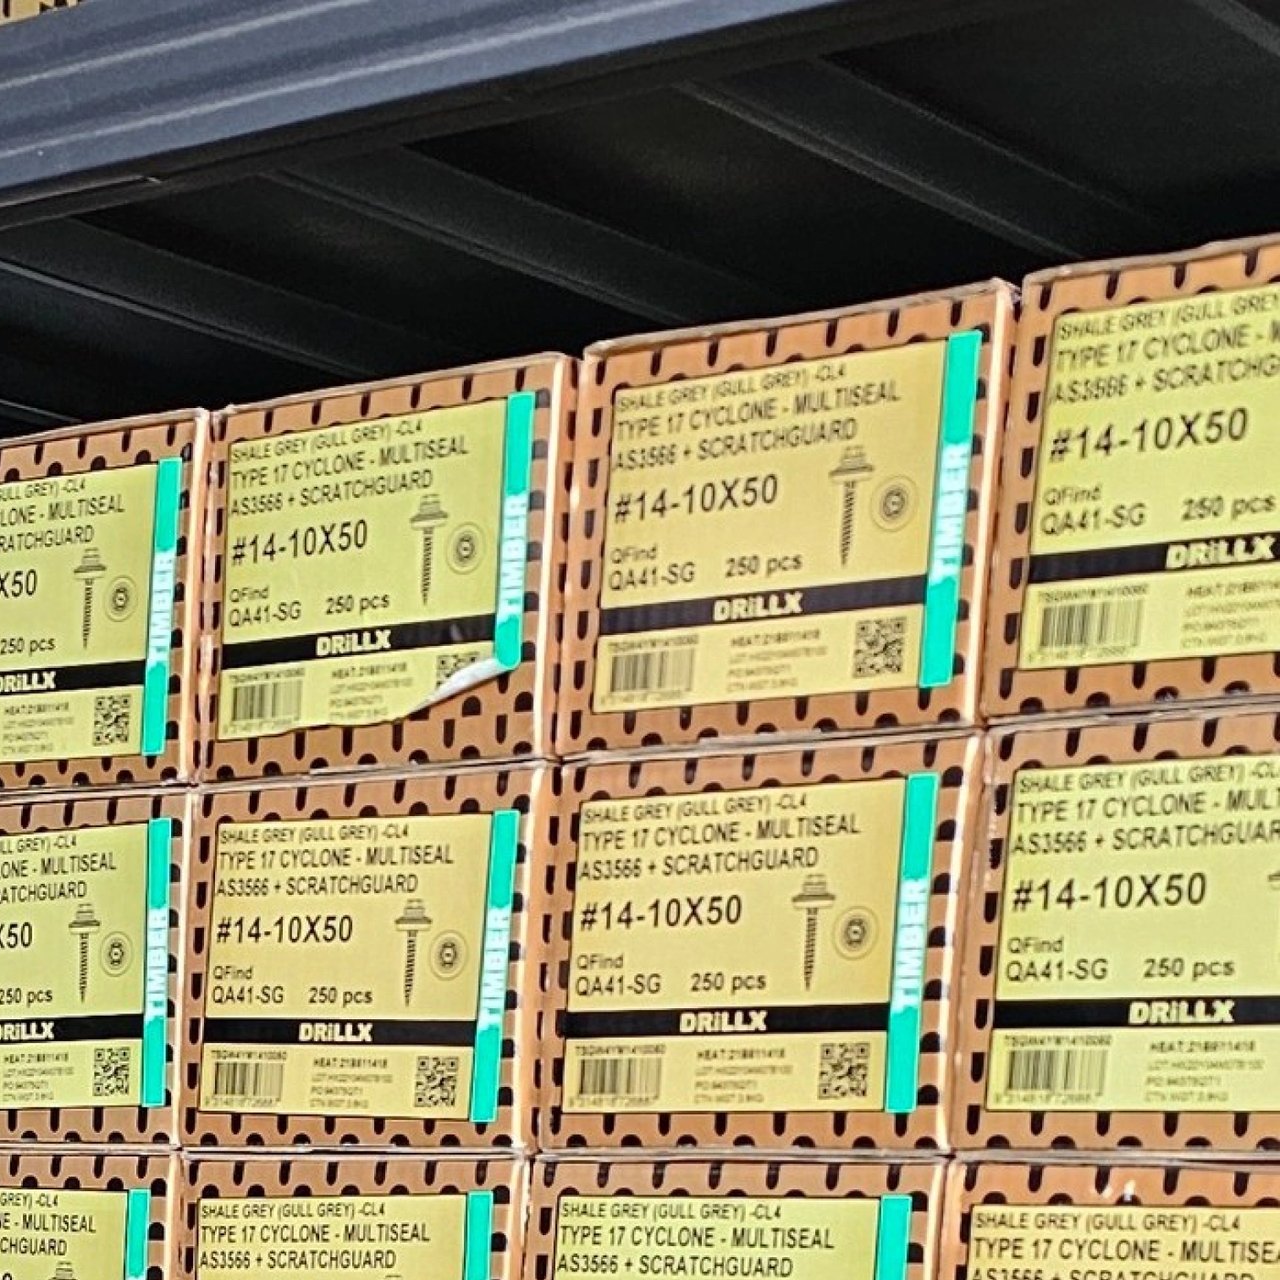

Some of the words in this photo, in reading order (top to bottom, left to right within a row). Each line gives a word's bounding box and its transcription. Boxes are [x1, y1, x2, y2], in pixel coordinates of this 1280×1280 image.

[1048, 405, 1249, 464] #14-10X50
[613, 472, 779, 526] #14-10X50
[231, 518, 369, 567] #14-10X50
[0, 638, 25, 657] 250
[29, 636, 56, 657] pcs
[662, 845, 819, 877] SCRATCHGUARD
[1011, 870, 1208, 913] #14-10X50
[579, 893, 743, 933] #14-10X50
[216, 914, 354, 945] #14-10X50
[575, 973, 662, 997] QA41-SG
[689, 972, 725, 992] 250
[730, 972, 767, 994] pcs
[560, 1202, 606, 1218] SHALE
[609, 1202, 648, 1218] GREY
[343, 1222, 430, 1243] MULTISEAL
[558, 1224, 602, 1246] TYPE
[608, 1226, 625, 1246] 17
[629, 1225, 715, 1248] CYCLONE
[730, 1226, 836, 1250] MULTISEAL
[557, 1252, 619, 1274] AS3566
[638, 1253, 794, 1278] SCRATCHGUARD
